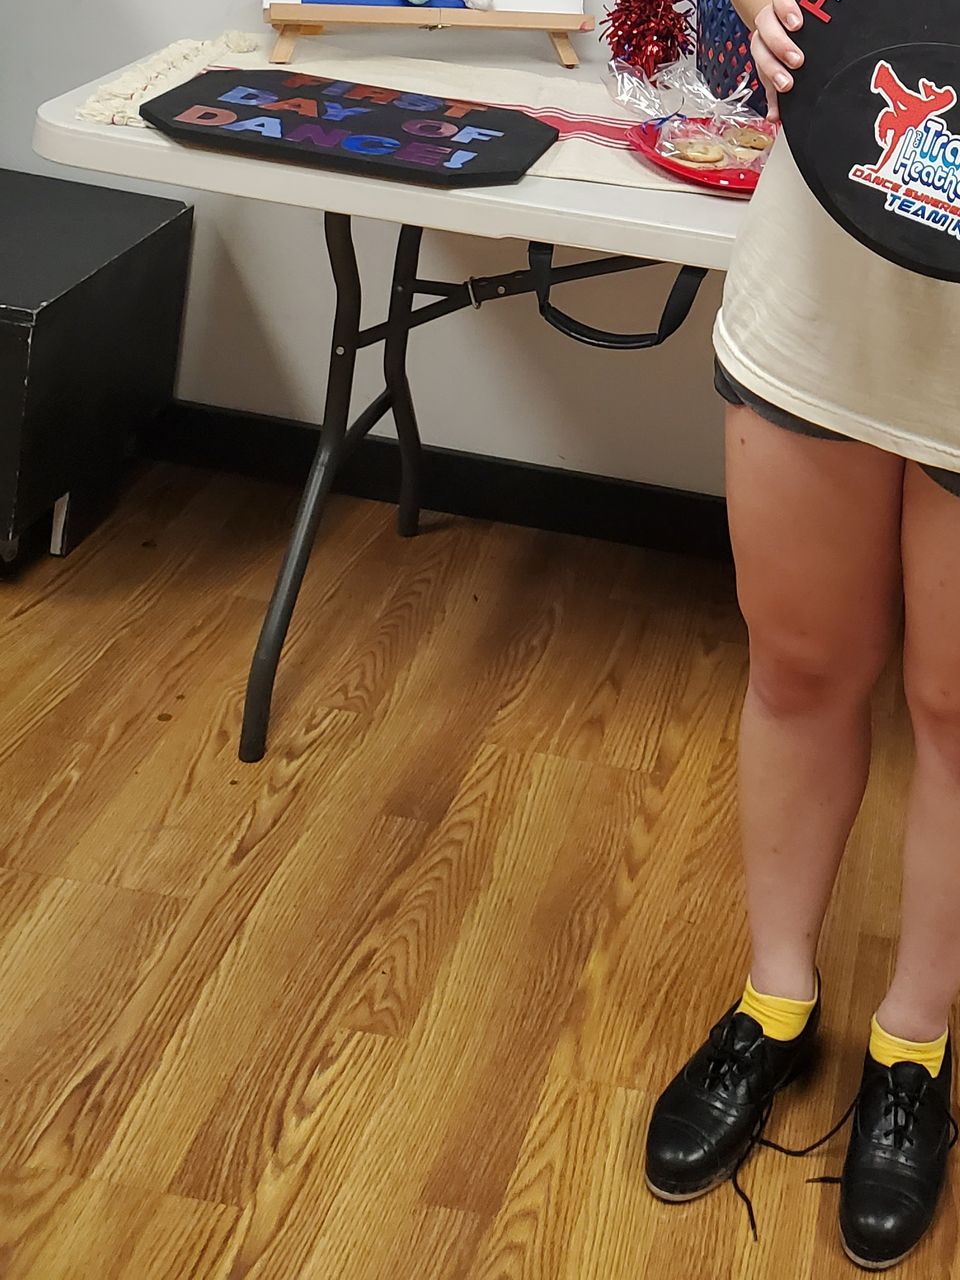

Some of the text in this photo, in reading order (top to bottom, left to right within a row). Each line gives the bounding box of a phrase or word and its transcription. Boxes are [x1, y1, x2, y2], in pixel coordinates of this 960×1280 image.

[217, 85, 505, 145] DAY OF
[281, 72, 490, 118] FIRST
[174, 104, 479, 169] DANCE!
[852, 167, 902, 194] DANCE
[887, 193, 948, 225] TEAM
